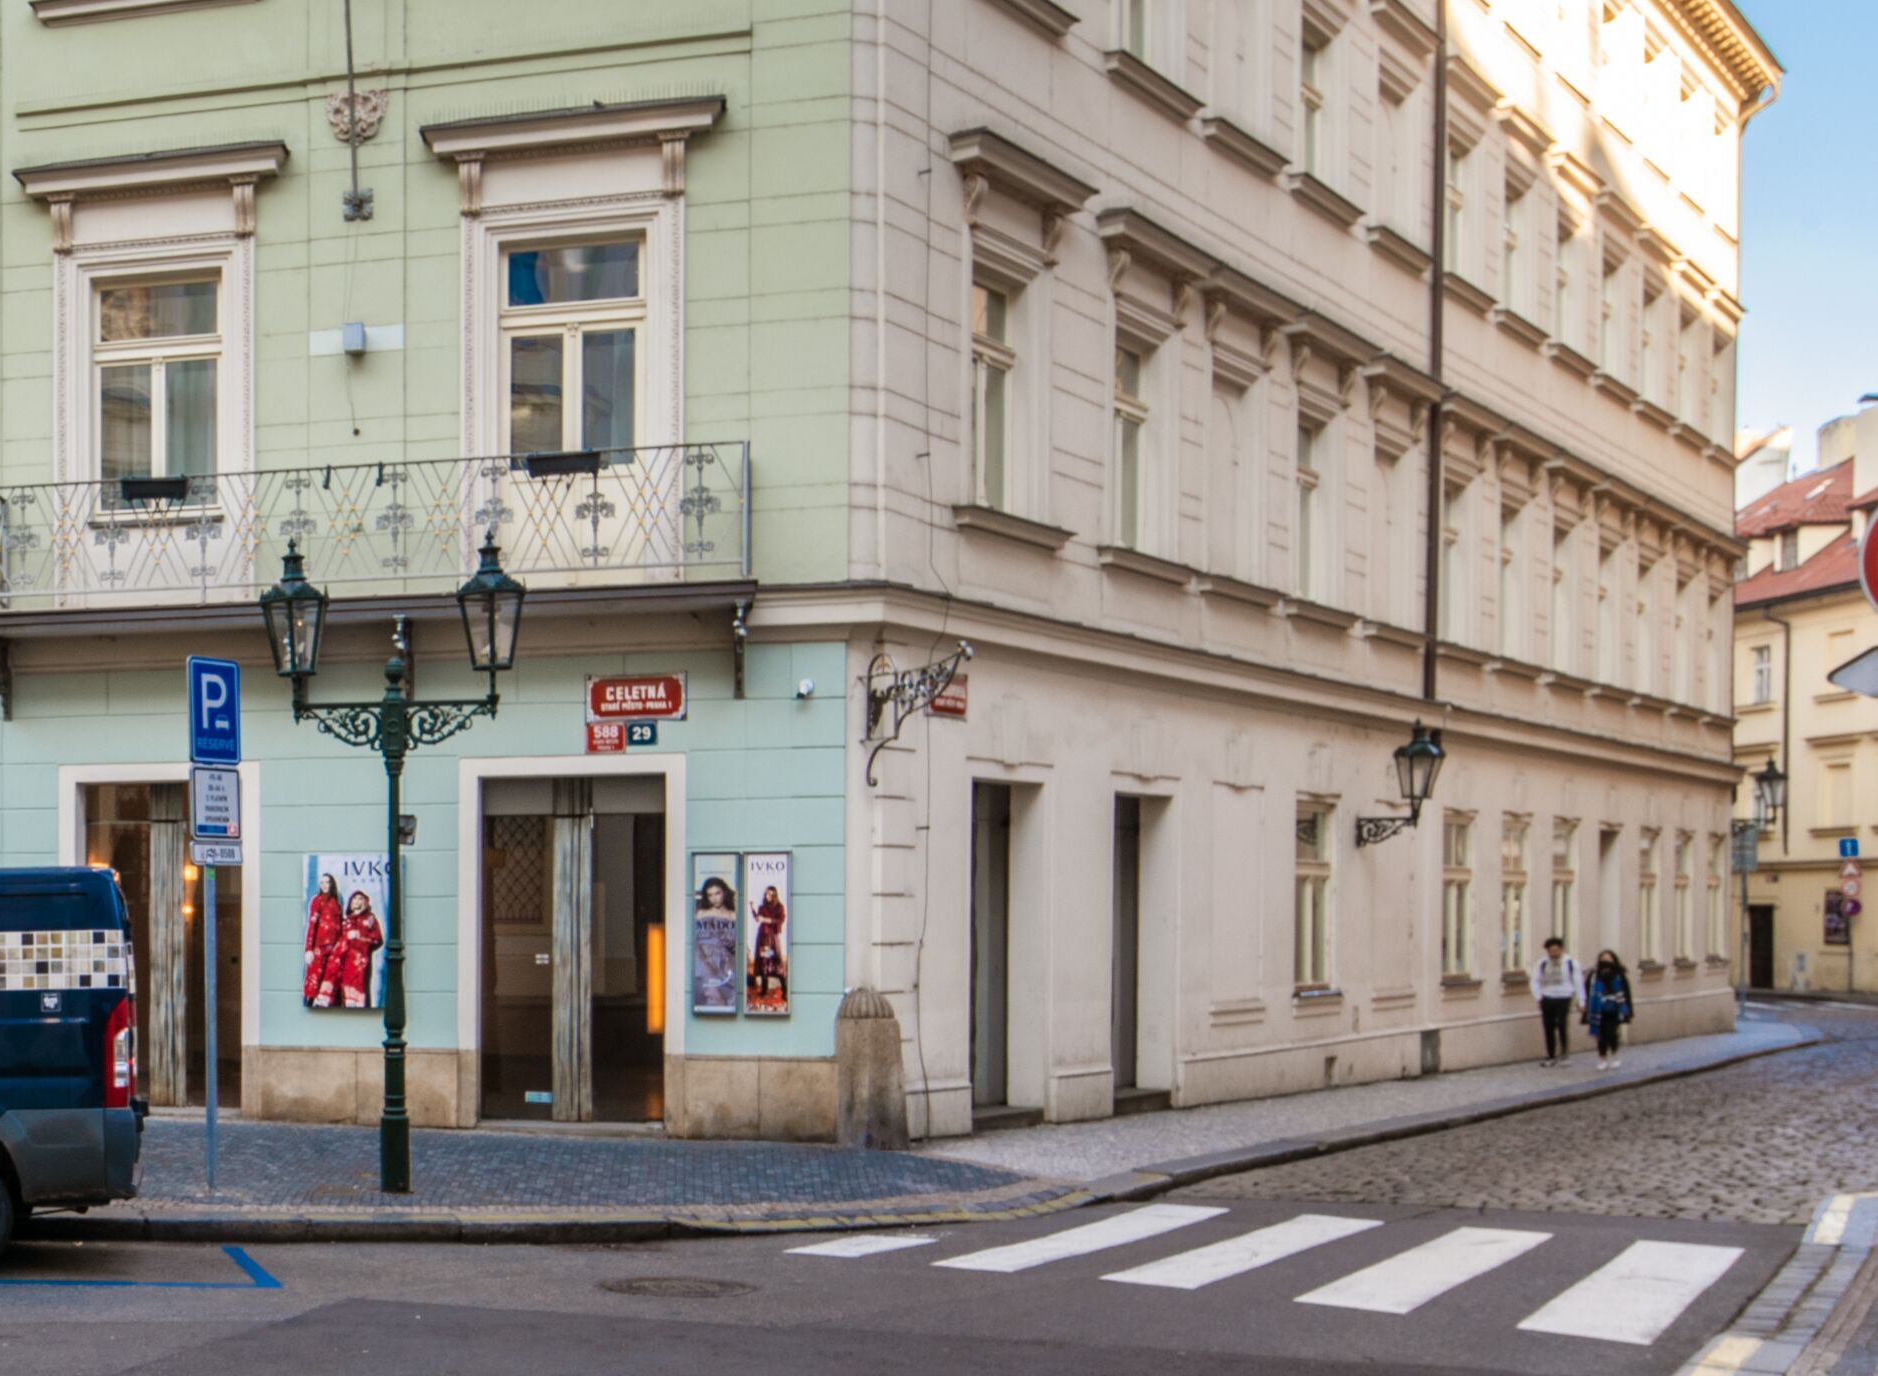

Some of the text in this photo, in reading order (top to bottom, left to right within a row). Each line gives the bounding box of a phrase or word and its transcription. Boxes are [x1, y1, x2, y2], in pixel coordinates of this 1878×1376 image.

[606, 682, 666, 700] CELETNÁ
[201, 672, 227, 729] P
[594, 725, 618, 739] 588
[632, 726, 651, 740] 29
[751, 861, 785, 871] IVKO
